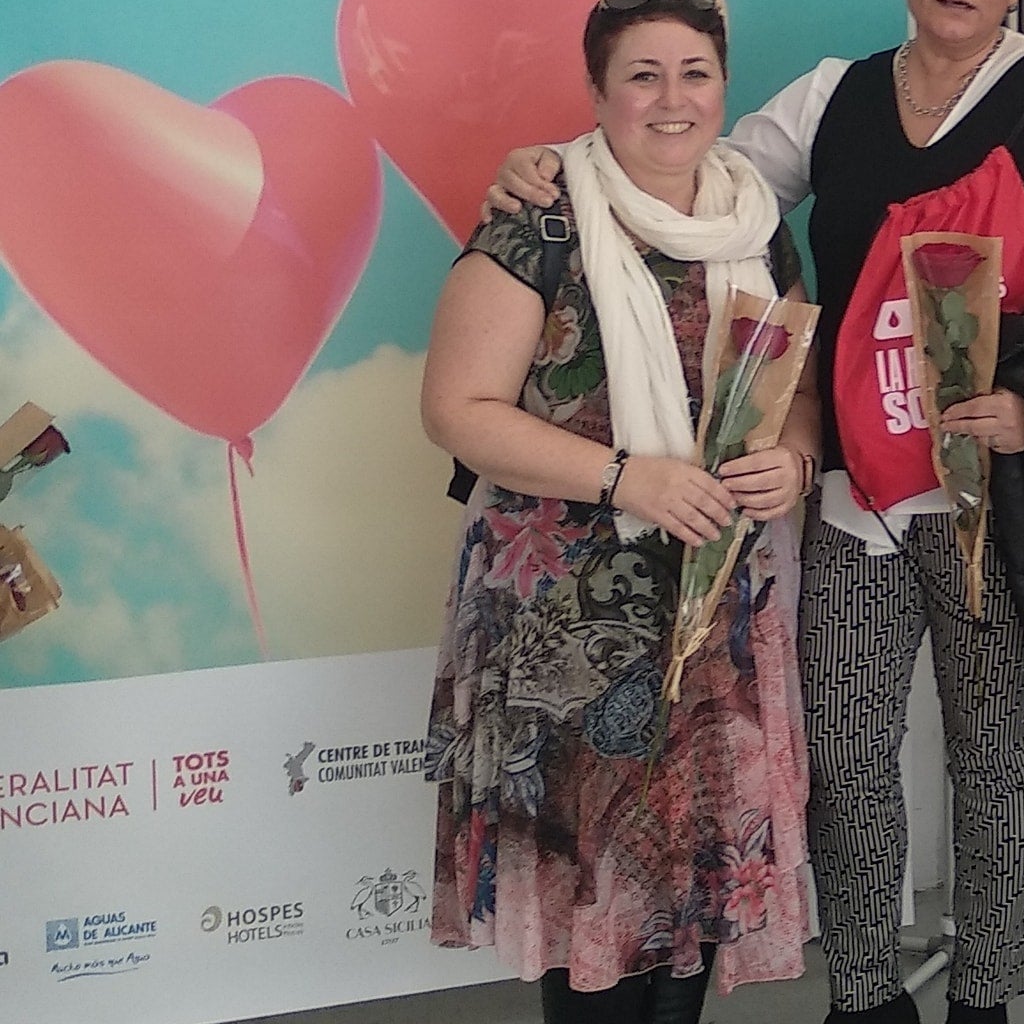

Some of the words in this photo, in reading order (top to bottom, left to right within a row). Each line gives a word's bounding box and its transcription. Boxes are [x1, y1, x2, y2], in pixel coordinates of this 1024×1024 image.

[172, 750, 230, 773] TOTS
[318, 745, 369, 763] CENTRE
[373, 742, 391, 757] DE
[173, 775, 186, 789] A
[191, 770, 230, 786] UNA
[318, 760, 387, 783] COMUNITAT
[179, 786, 224, 808] veu
[0, 793, 130, 829] NCIANA
[83, 912, 126, 927] AGUAS
[228, 902, 304, 927] HOSPES
[83, 929, 98, 941] DE
[104, 921, 157, 938] ALICANTE
[228, 924, 283, 944] HOTELS
[346, 925, 381, 939] CASA
